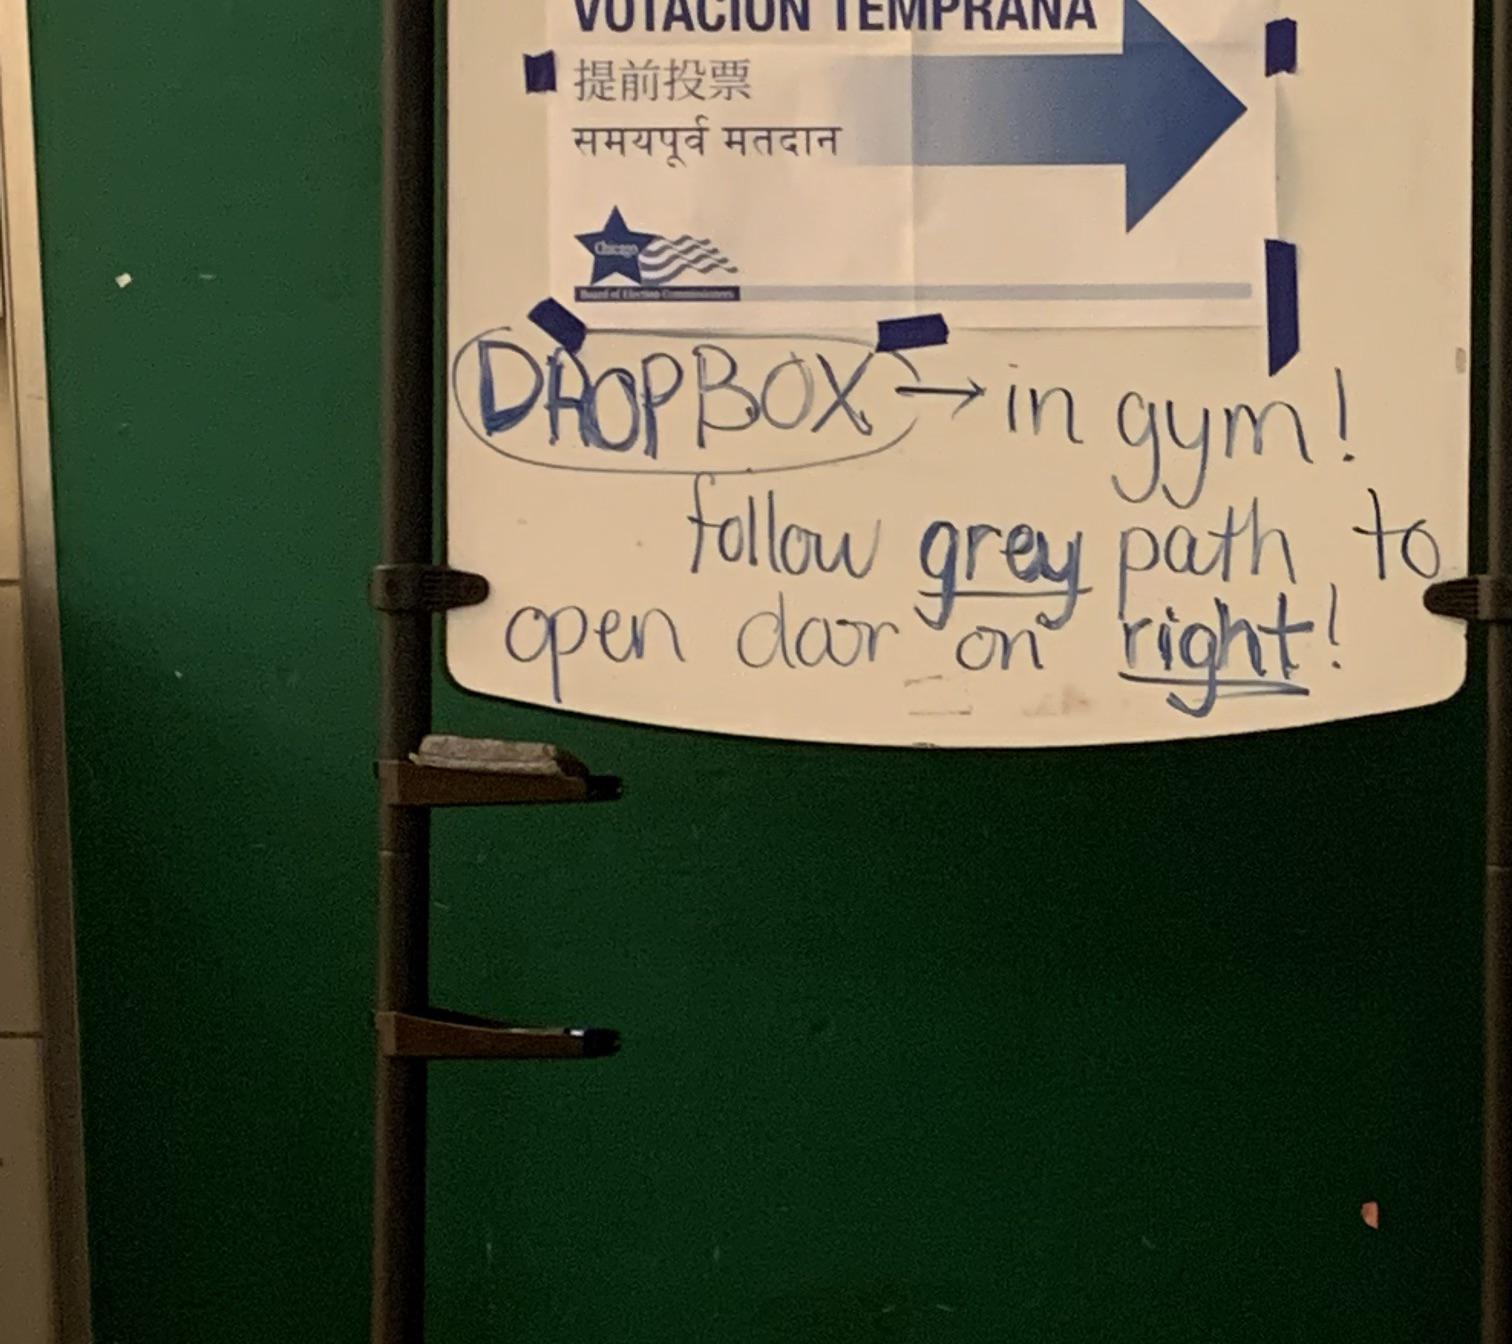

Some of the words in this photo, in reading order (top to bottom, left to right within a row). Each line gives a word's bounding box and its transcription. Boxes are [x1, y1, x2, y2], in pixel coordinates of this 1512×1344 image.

[574, 58, 752, 102] 提前投票
[571, 114, 709, 168] समयपूर्व
[721, 126, 843, 156] मतदान
[594, 239, 639, 258] Chicago
[1008, 364, 1083, 446] in
[917, 516, 1085, 630] grey
[1118, 508, 1298, 618] path
[1352, 489, 1442, 581] to
[505, 602, 685, 703] open
[956, 622, 1044, 673] on
